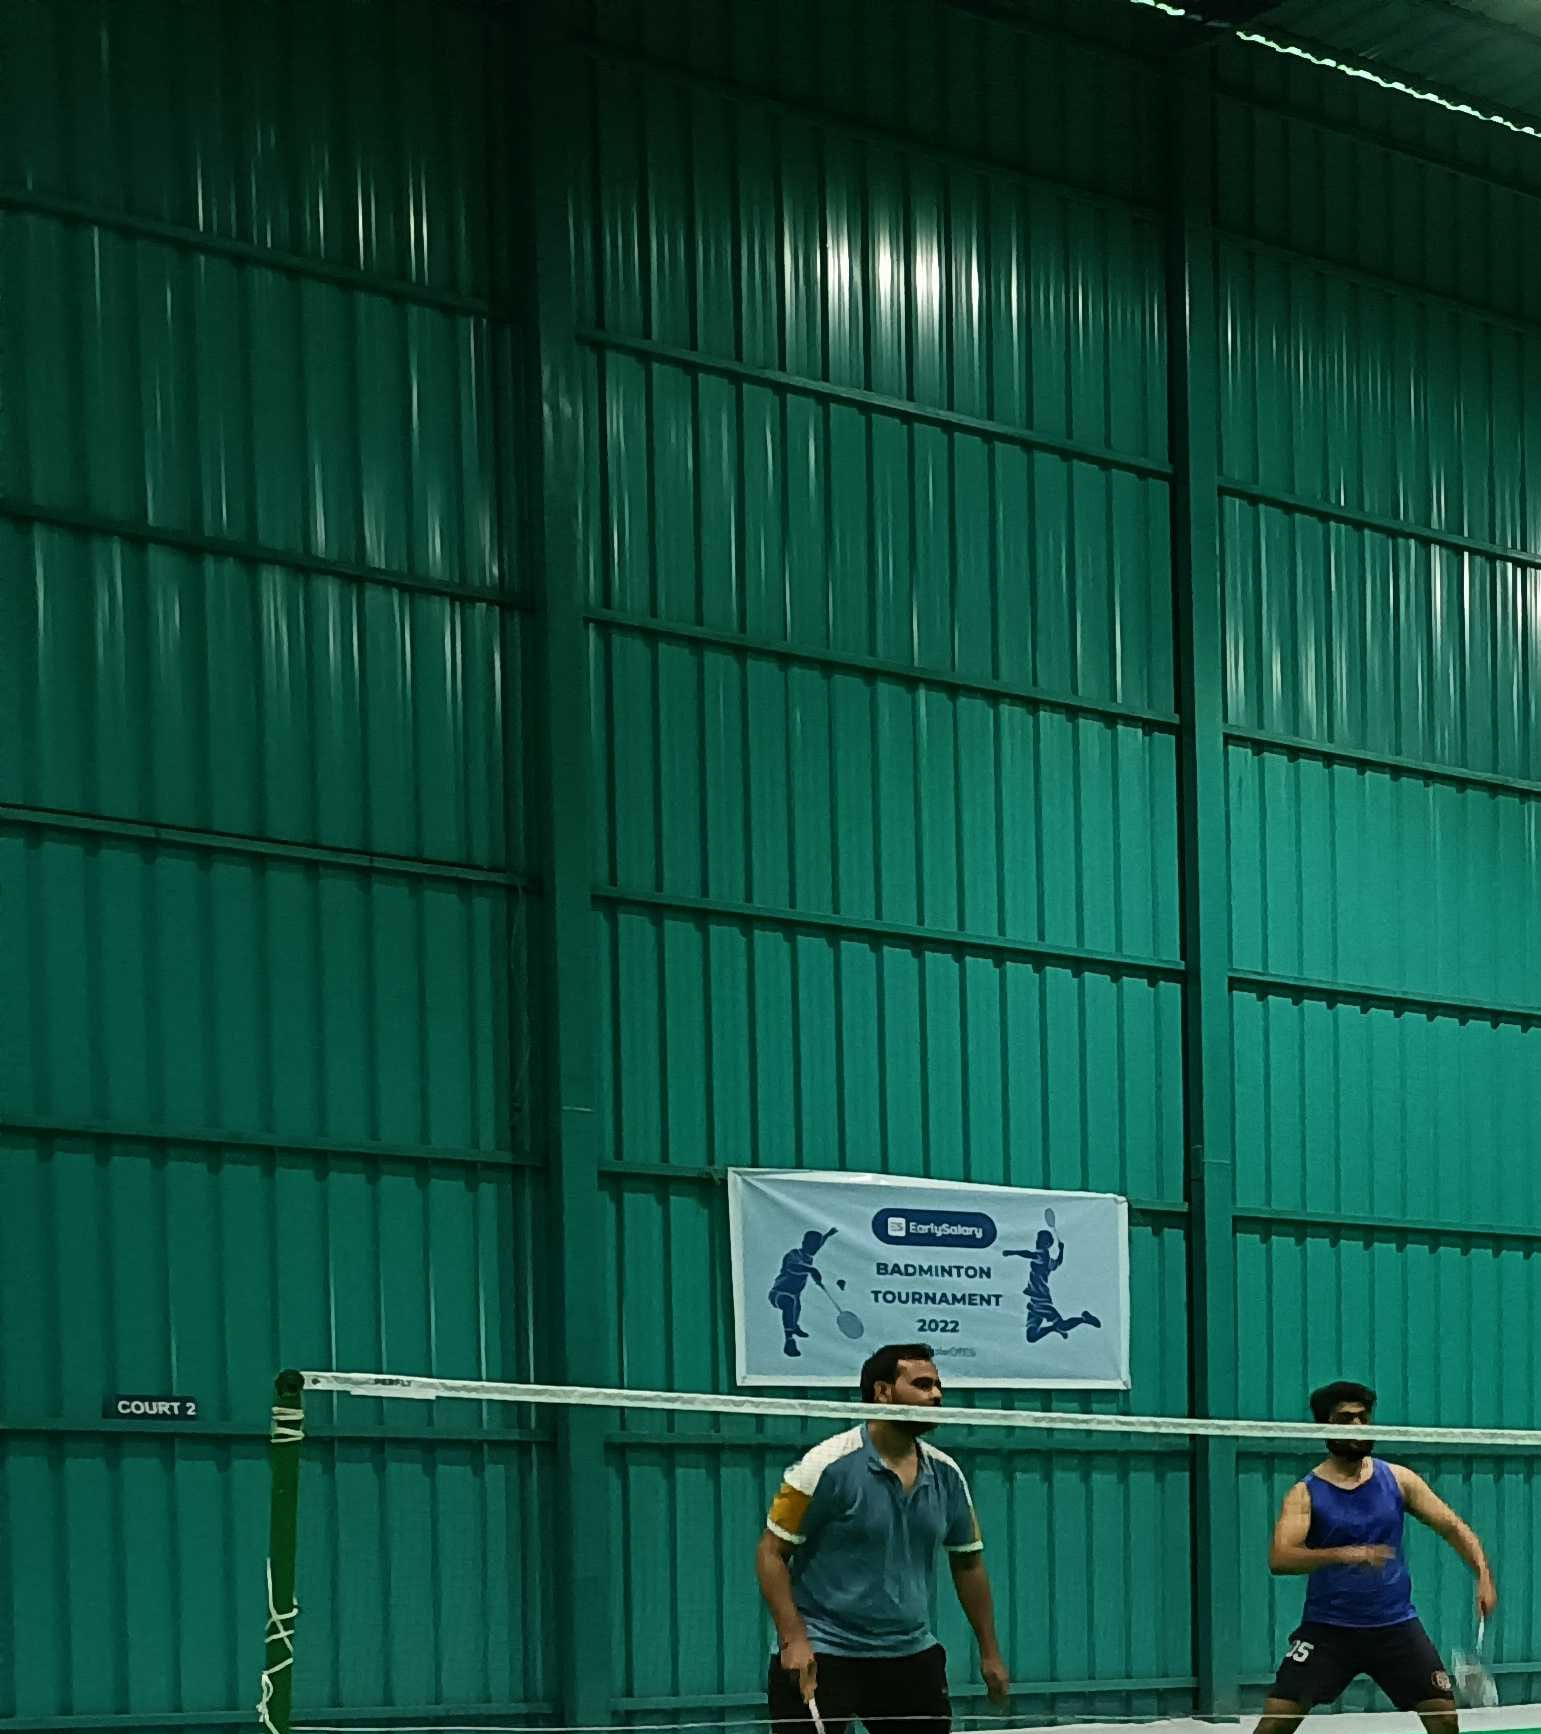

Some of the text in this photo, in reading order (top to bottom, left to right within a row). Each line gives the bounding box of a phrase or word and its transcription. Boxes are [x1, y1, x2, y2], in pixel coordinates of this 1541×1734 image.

[909, 1221, 983, 1239] EarlySalary
[876, 1262, 992, 1279] BADMINTON
[870, 1290, 1003, 1307] TOURNAMENT
[917, 1319, 960, 1333] 2022
[117, 1400, 197, 1416] COURT 2
